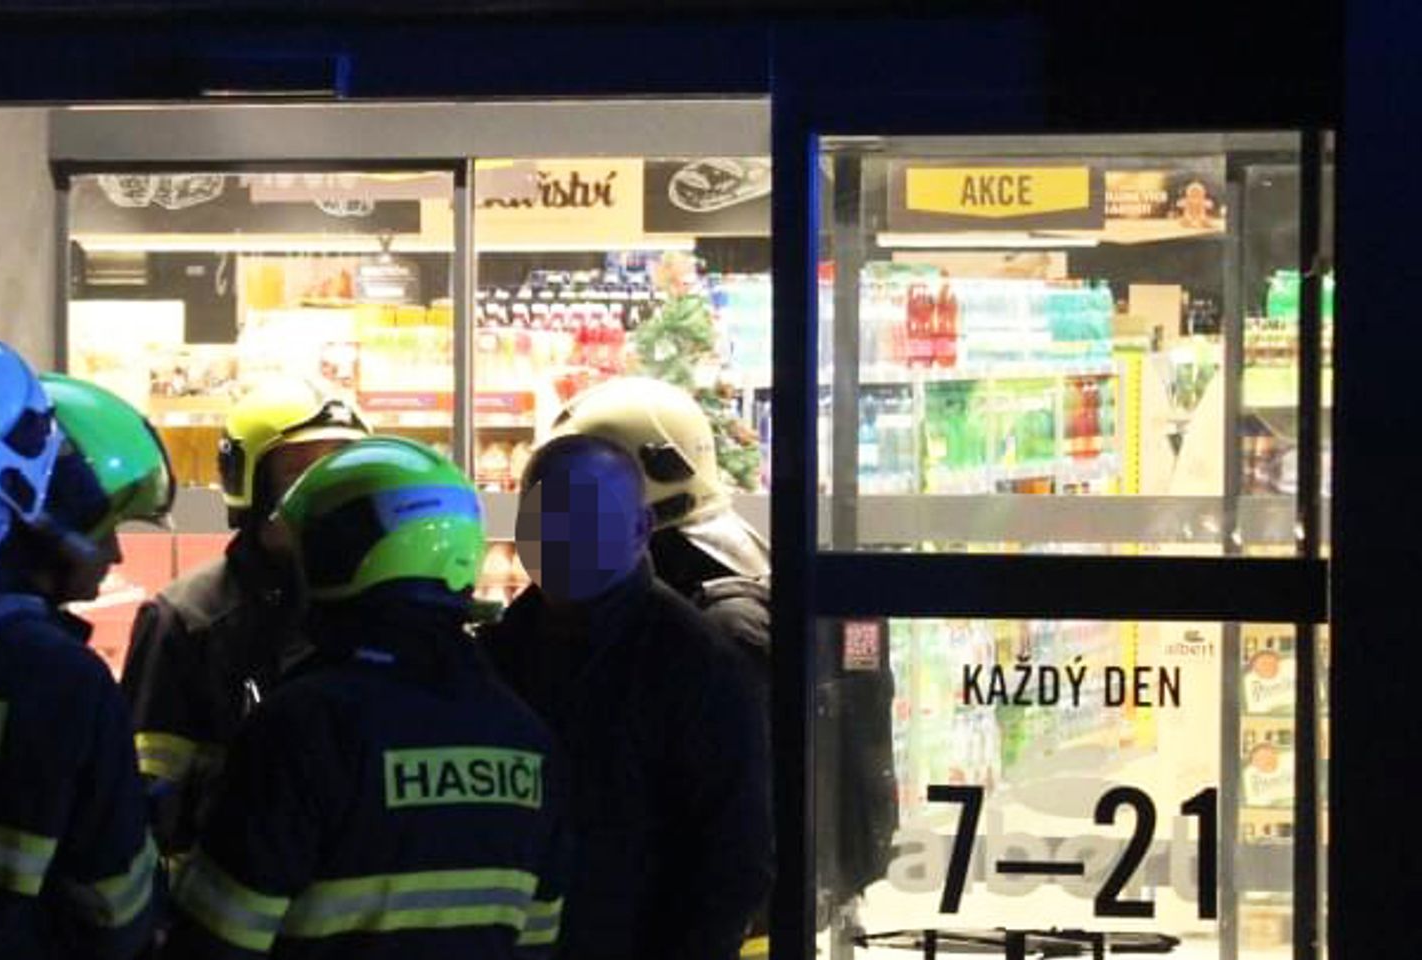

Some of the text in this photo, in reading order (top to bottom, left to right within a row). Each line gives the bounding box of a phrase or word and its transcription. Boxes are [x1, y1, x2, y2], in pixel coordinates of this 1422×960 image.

[960, 174, 1034, 206] AKCE
[962, 655, 1182, 708] KAŽDÝ DEN
